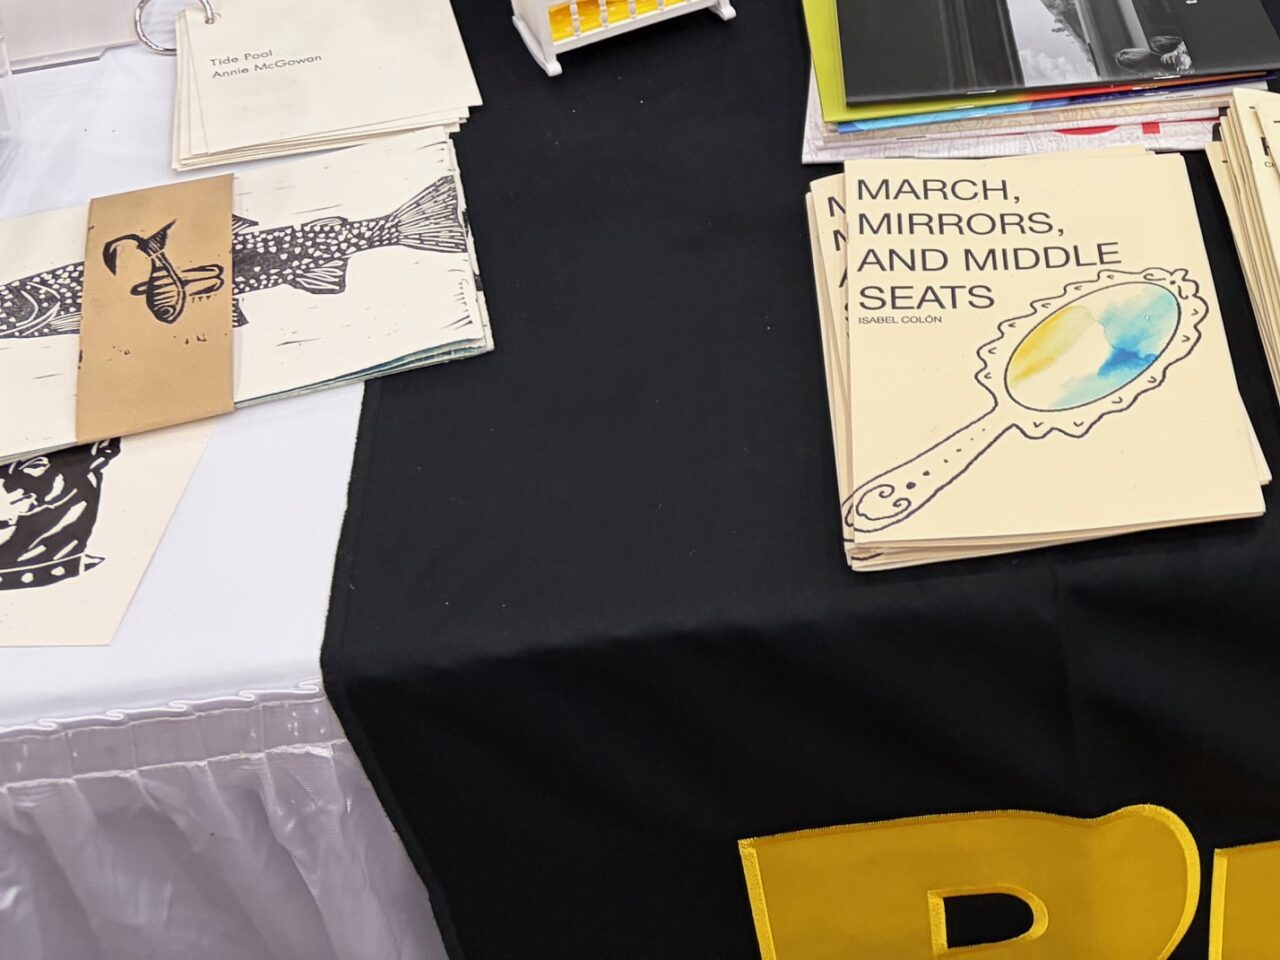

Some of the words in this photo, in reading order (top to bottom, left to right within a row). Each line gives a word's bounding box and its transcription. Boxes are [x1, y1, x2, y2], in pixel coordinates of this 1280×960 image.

[210, 55, 239, 67] Tide
[244, 49, 273, 61] Pool
[212, 67, 249, 79] Annie
[254, 55, 322, 71] McGowan
[857, 178, 1021, 204] MARCH,
[858, 212, 1065, 236] MIRRORS,
[857, 248, 949, 272] AND
[964, 241, 1123, 271] MIDDLE
[858, 285, 996, 311] SEATS
[858, 316, 899, 325] ISABEL
[901, 314, 943, 325] COLÓN
